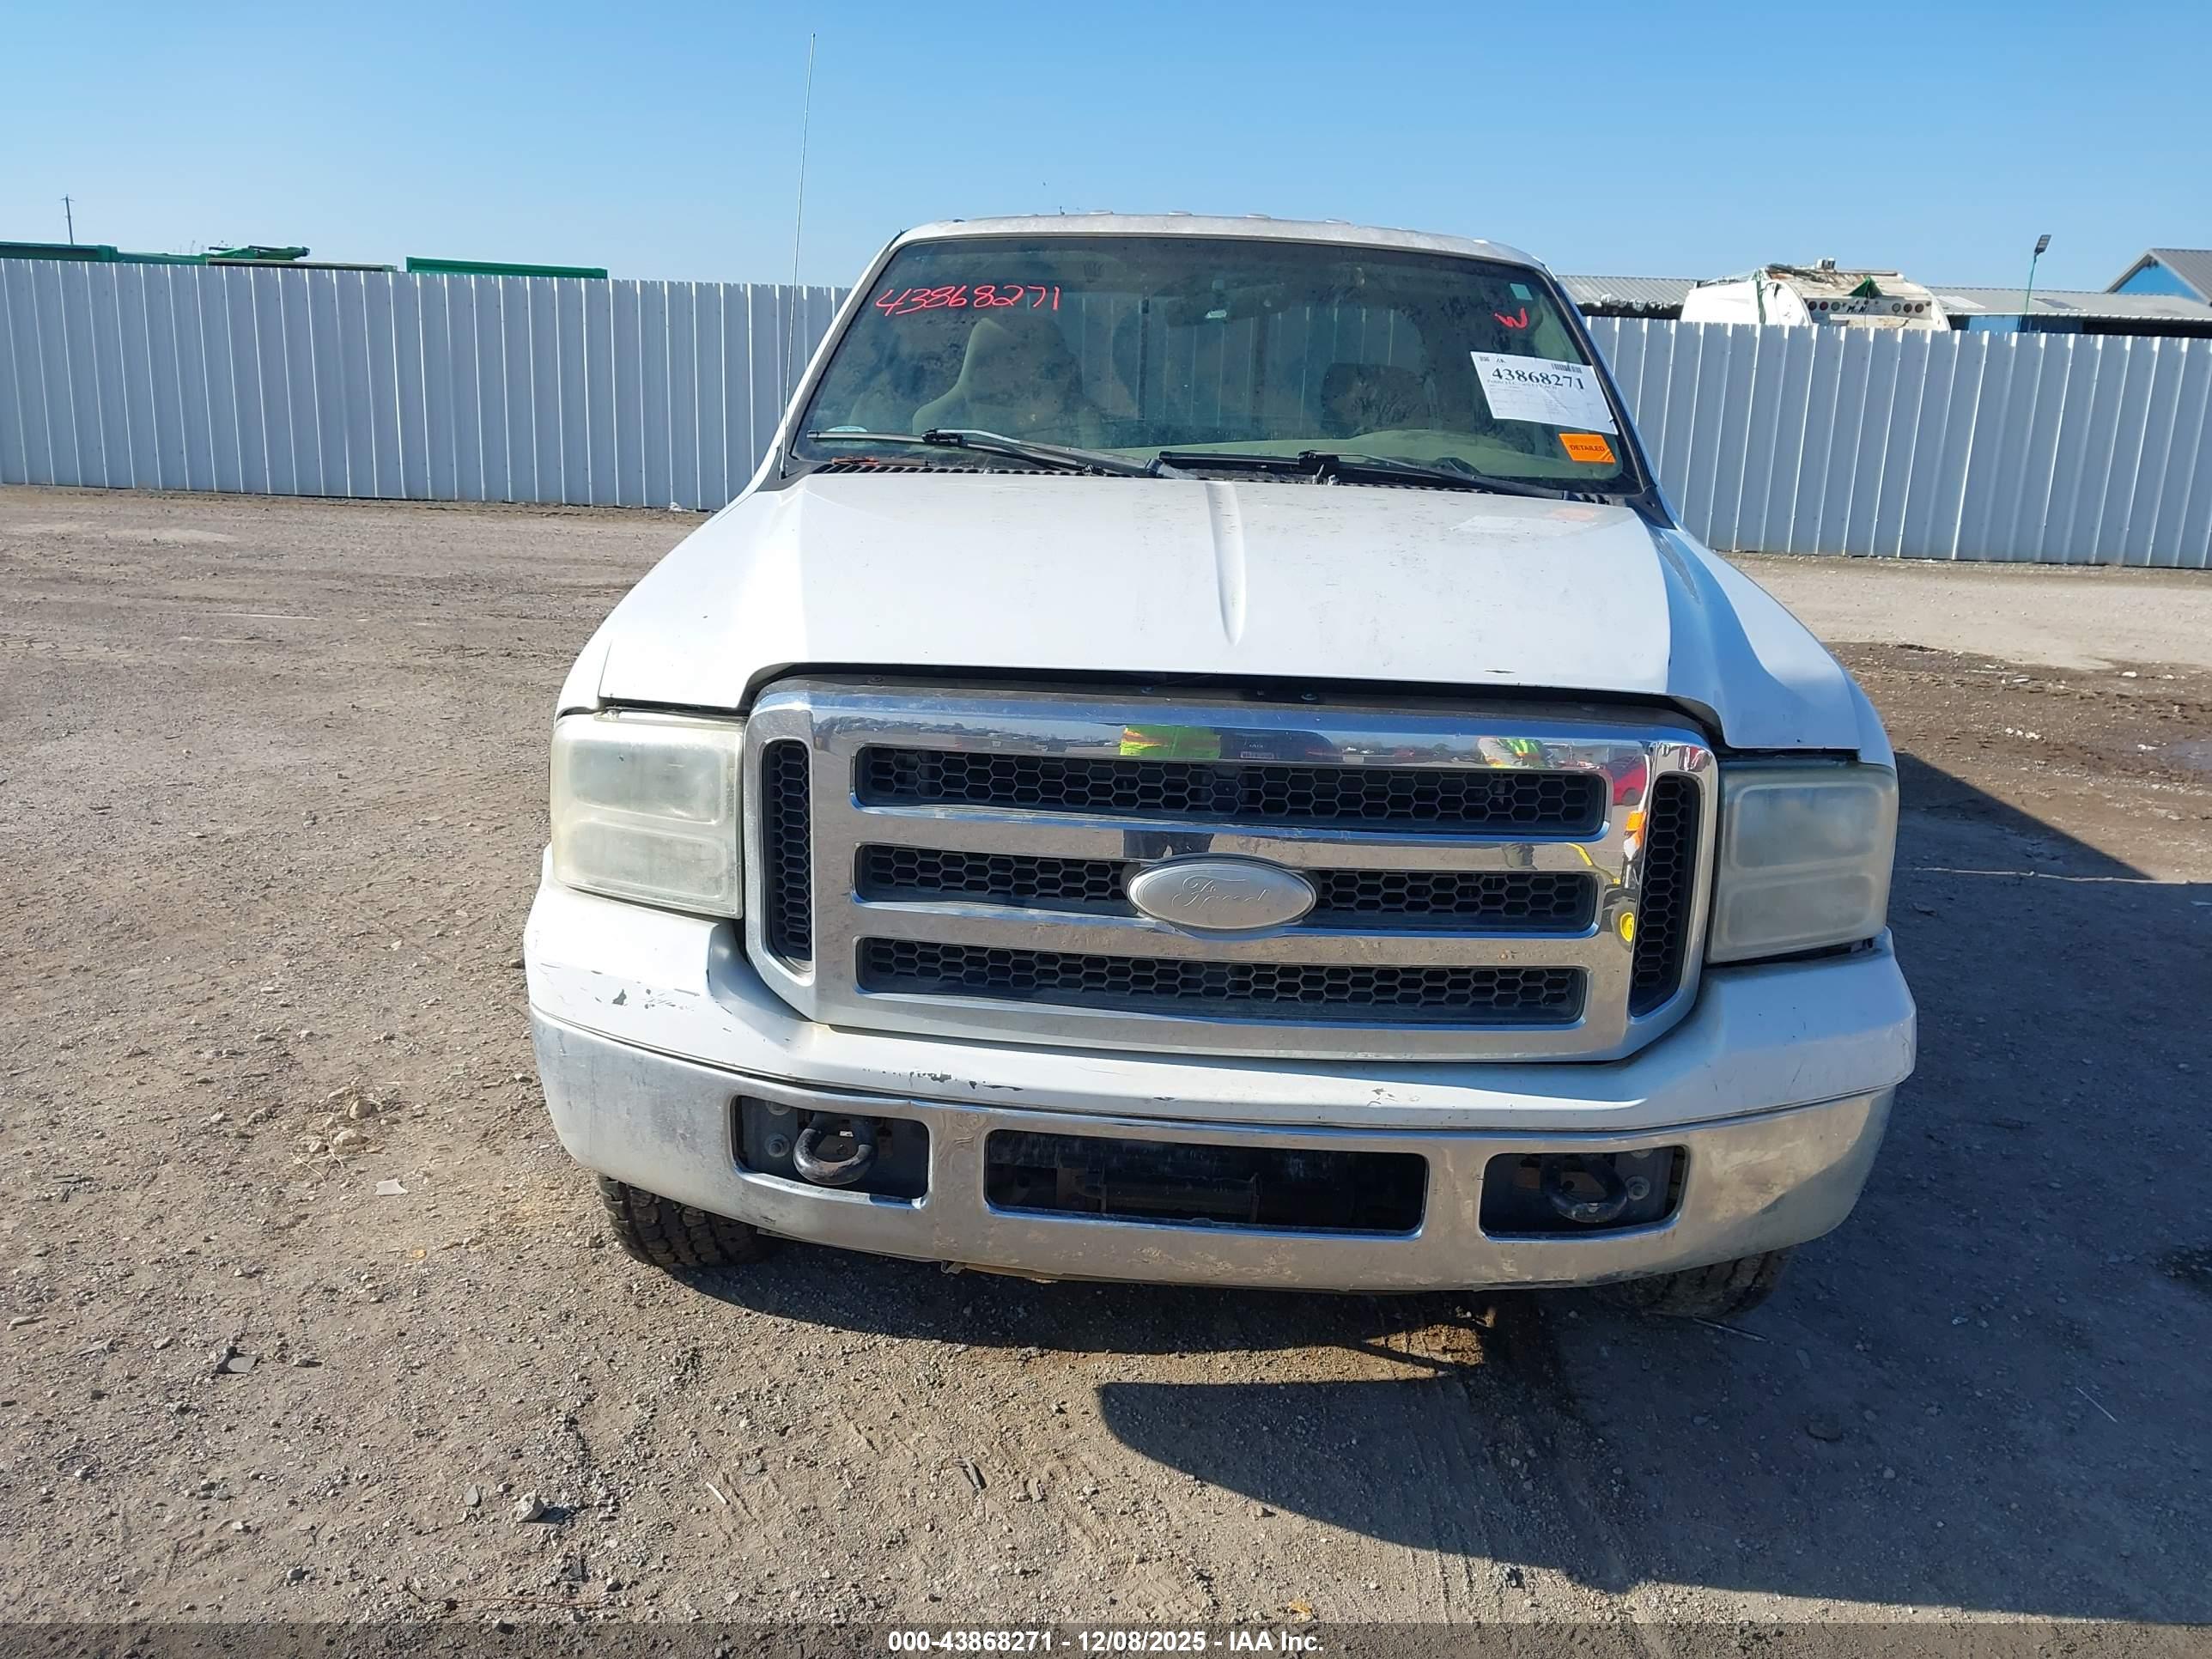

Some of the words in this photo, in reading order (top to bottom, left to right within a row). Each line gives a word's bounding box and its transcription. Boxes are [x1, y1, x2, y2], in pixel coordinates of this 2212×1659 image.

[876, 284, 1060, 317] 43868271
[1492, 368, 1585, 390] 43868271
[1569, 444, 1606, 453] DETAILED
[1171, 874, 1272, 910] Ford
